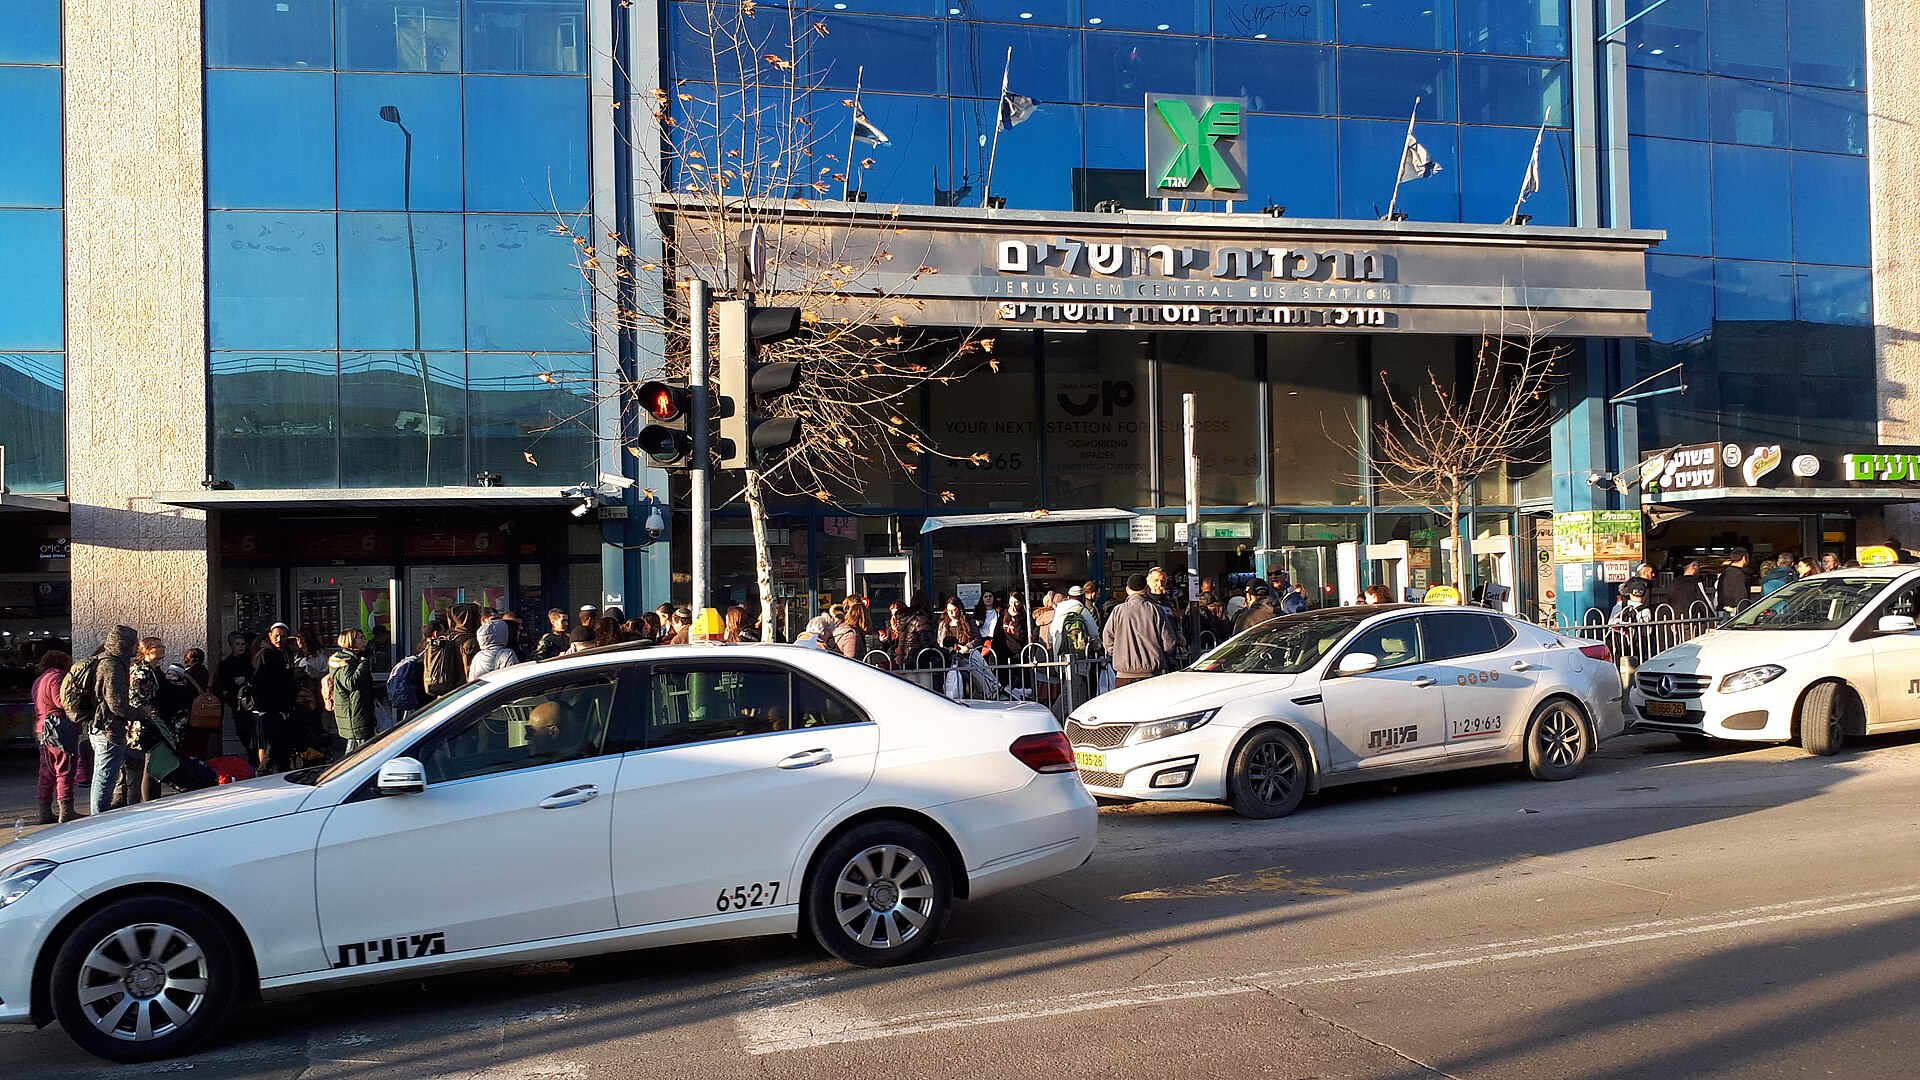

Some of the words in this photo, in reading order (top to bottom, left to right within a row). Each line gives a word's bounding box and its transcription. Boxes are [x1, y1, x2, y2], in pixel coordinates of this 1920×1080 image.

[1166, 176, 1187, 188] אגד
[998, 236, 1194, 276] ירושלים
[1211, 247, 1384, 279] מרכזית
[994, 281, 1122, 296] JERUSALEM
[1138, 284, 1234, 298] CENTRAL
[1249, 286, 1286, 299] BUS
[1302, 287, 1392, 300] STATION
[1123, 304, 1200, 322] מסחר
[1209, 306, 1311, 324] תחבורה
[1322, 307, 1385, 325] מרכז
[945, 421, 988, 434] YOUR
[995, 421, 1035, 434] NEXT
[1046, 421, 1111, 434] STATION
[1118, 421, 1150, 434] FOR
[1160, 420, 1231, 433] SUCESS
[1067, 439, 1128, 448] COWORKING
[1080, 451, 1117, 460] SPACES
[1673, 447, 1715, 468] פשוט
[1675, 468, 1715, 488] טעים
[240, 534, 256, 553] 6
[361, 533, 376, 551] 6
[475, 532, 489, 550] 6
[1486, 591, 1500, 601] Gett
[1367, 724, 1418, 749] מונית
[334, 932, 446, 968] מונית
